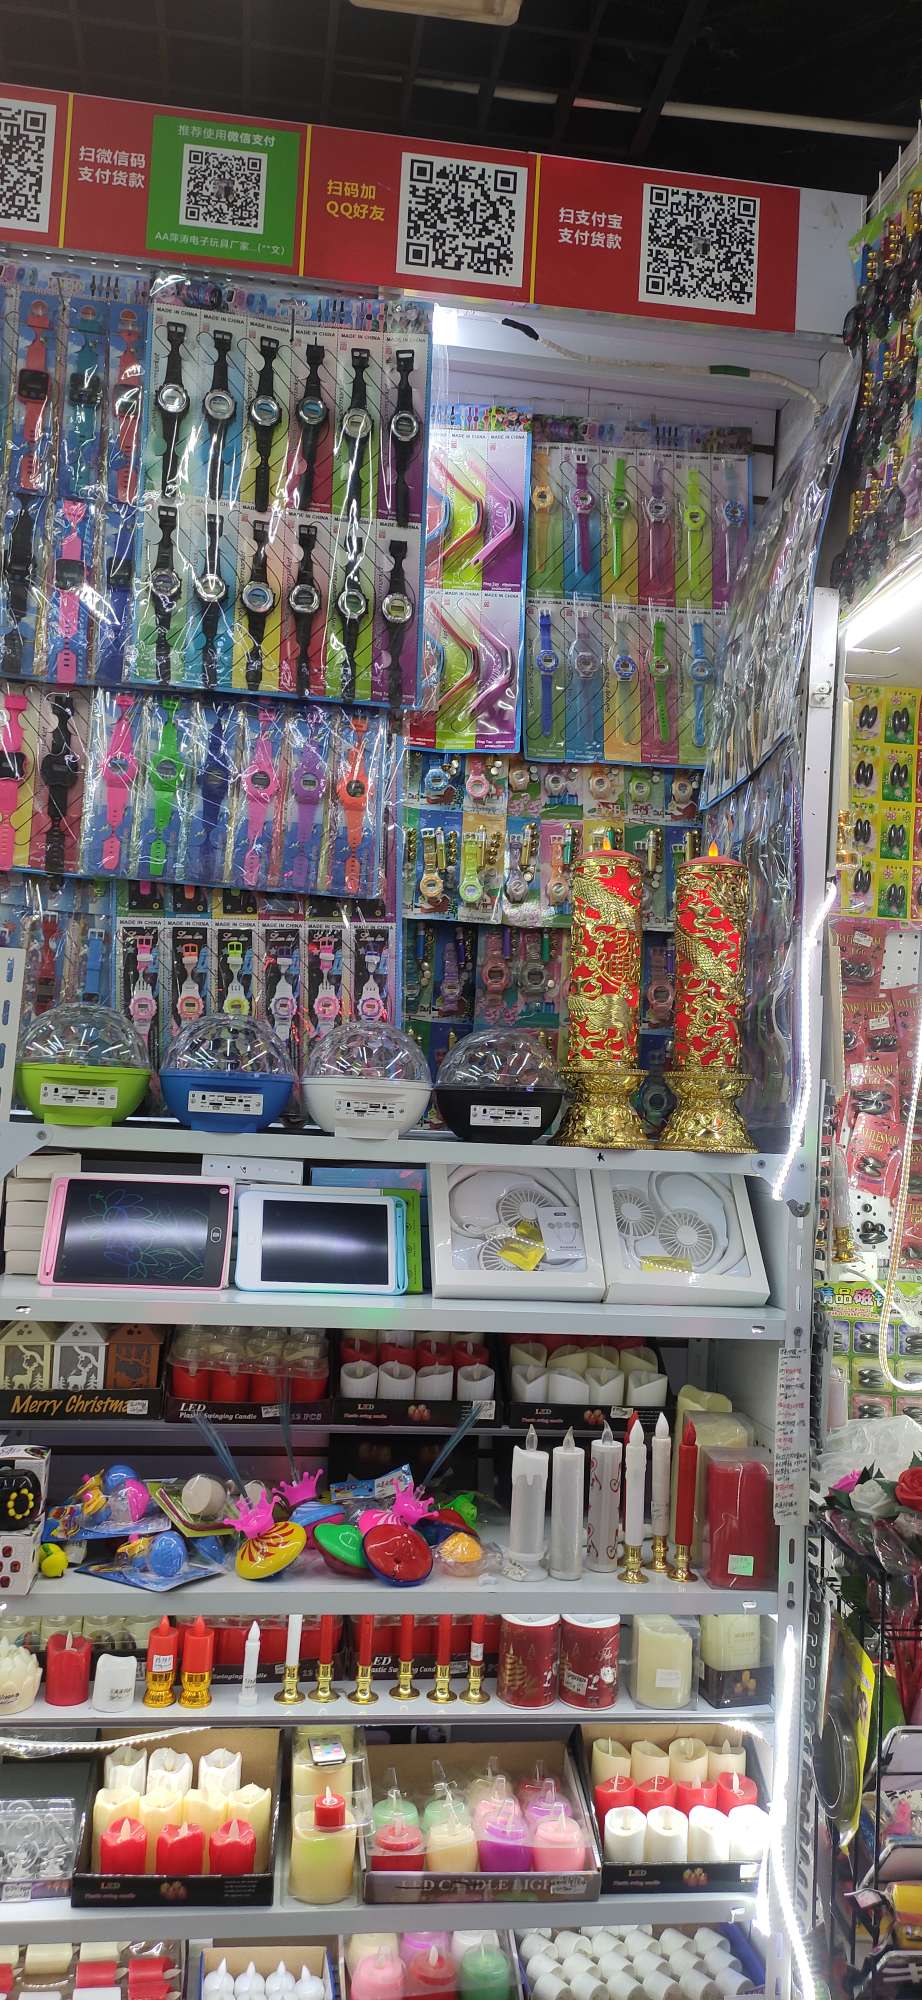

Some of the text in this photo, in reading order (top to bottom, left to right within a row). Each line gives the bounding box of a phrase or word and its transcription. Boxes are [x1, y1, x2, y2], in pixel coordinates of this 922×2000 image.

[177, 124, 276, 148] 推荐使用微信支付
[79, 145, 146, 169] 扫微信码
[78, 166, 145, 188] 支付货款
[327, 179, 376, 200] 扫码加
[326, 200, 386, 222] QQ好友
[558, 207, 623, 230] 扫支付宝
[558, 227, 622, 250] 支付货款
[10, 1394, 63, 1416] Merry
[65, 1394, 128, 1413] Christma
[180, 1402, 206, 1412] LED
[373, 1656, 391, 1665] ED
